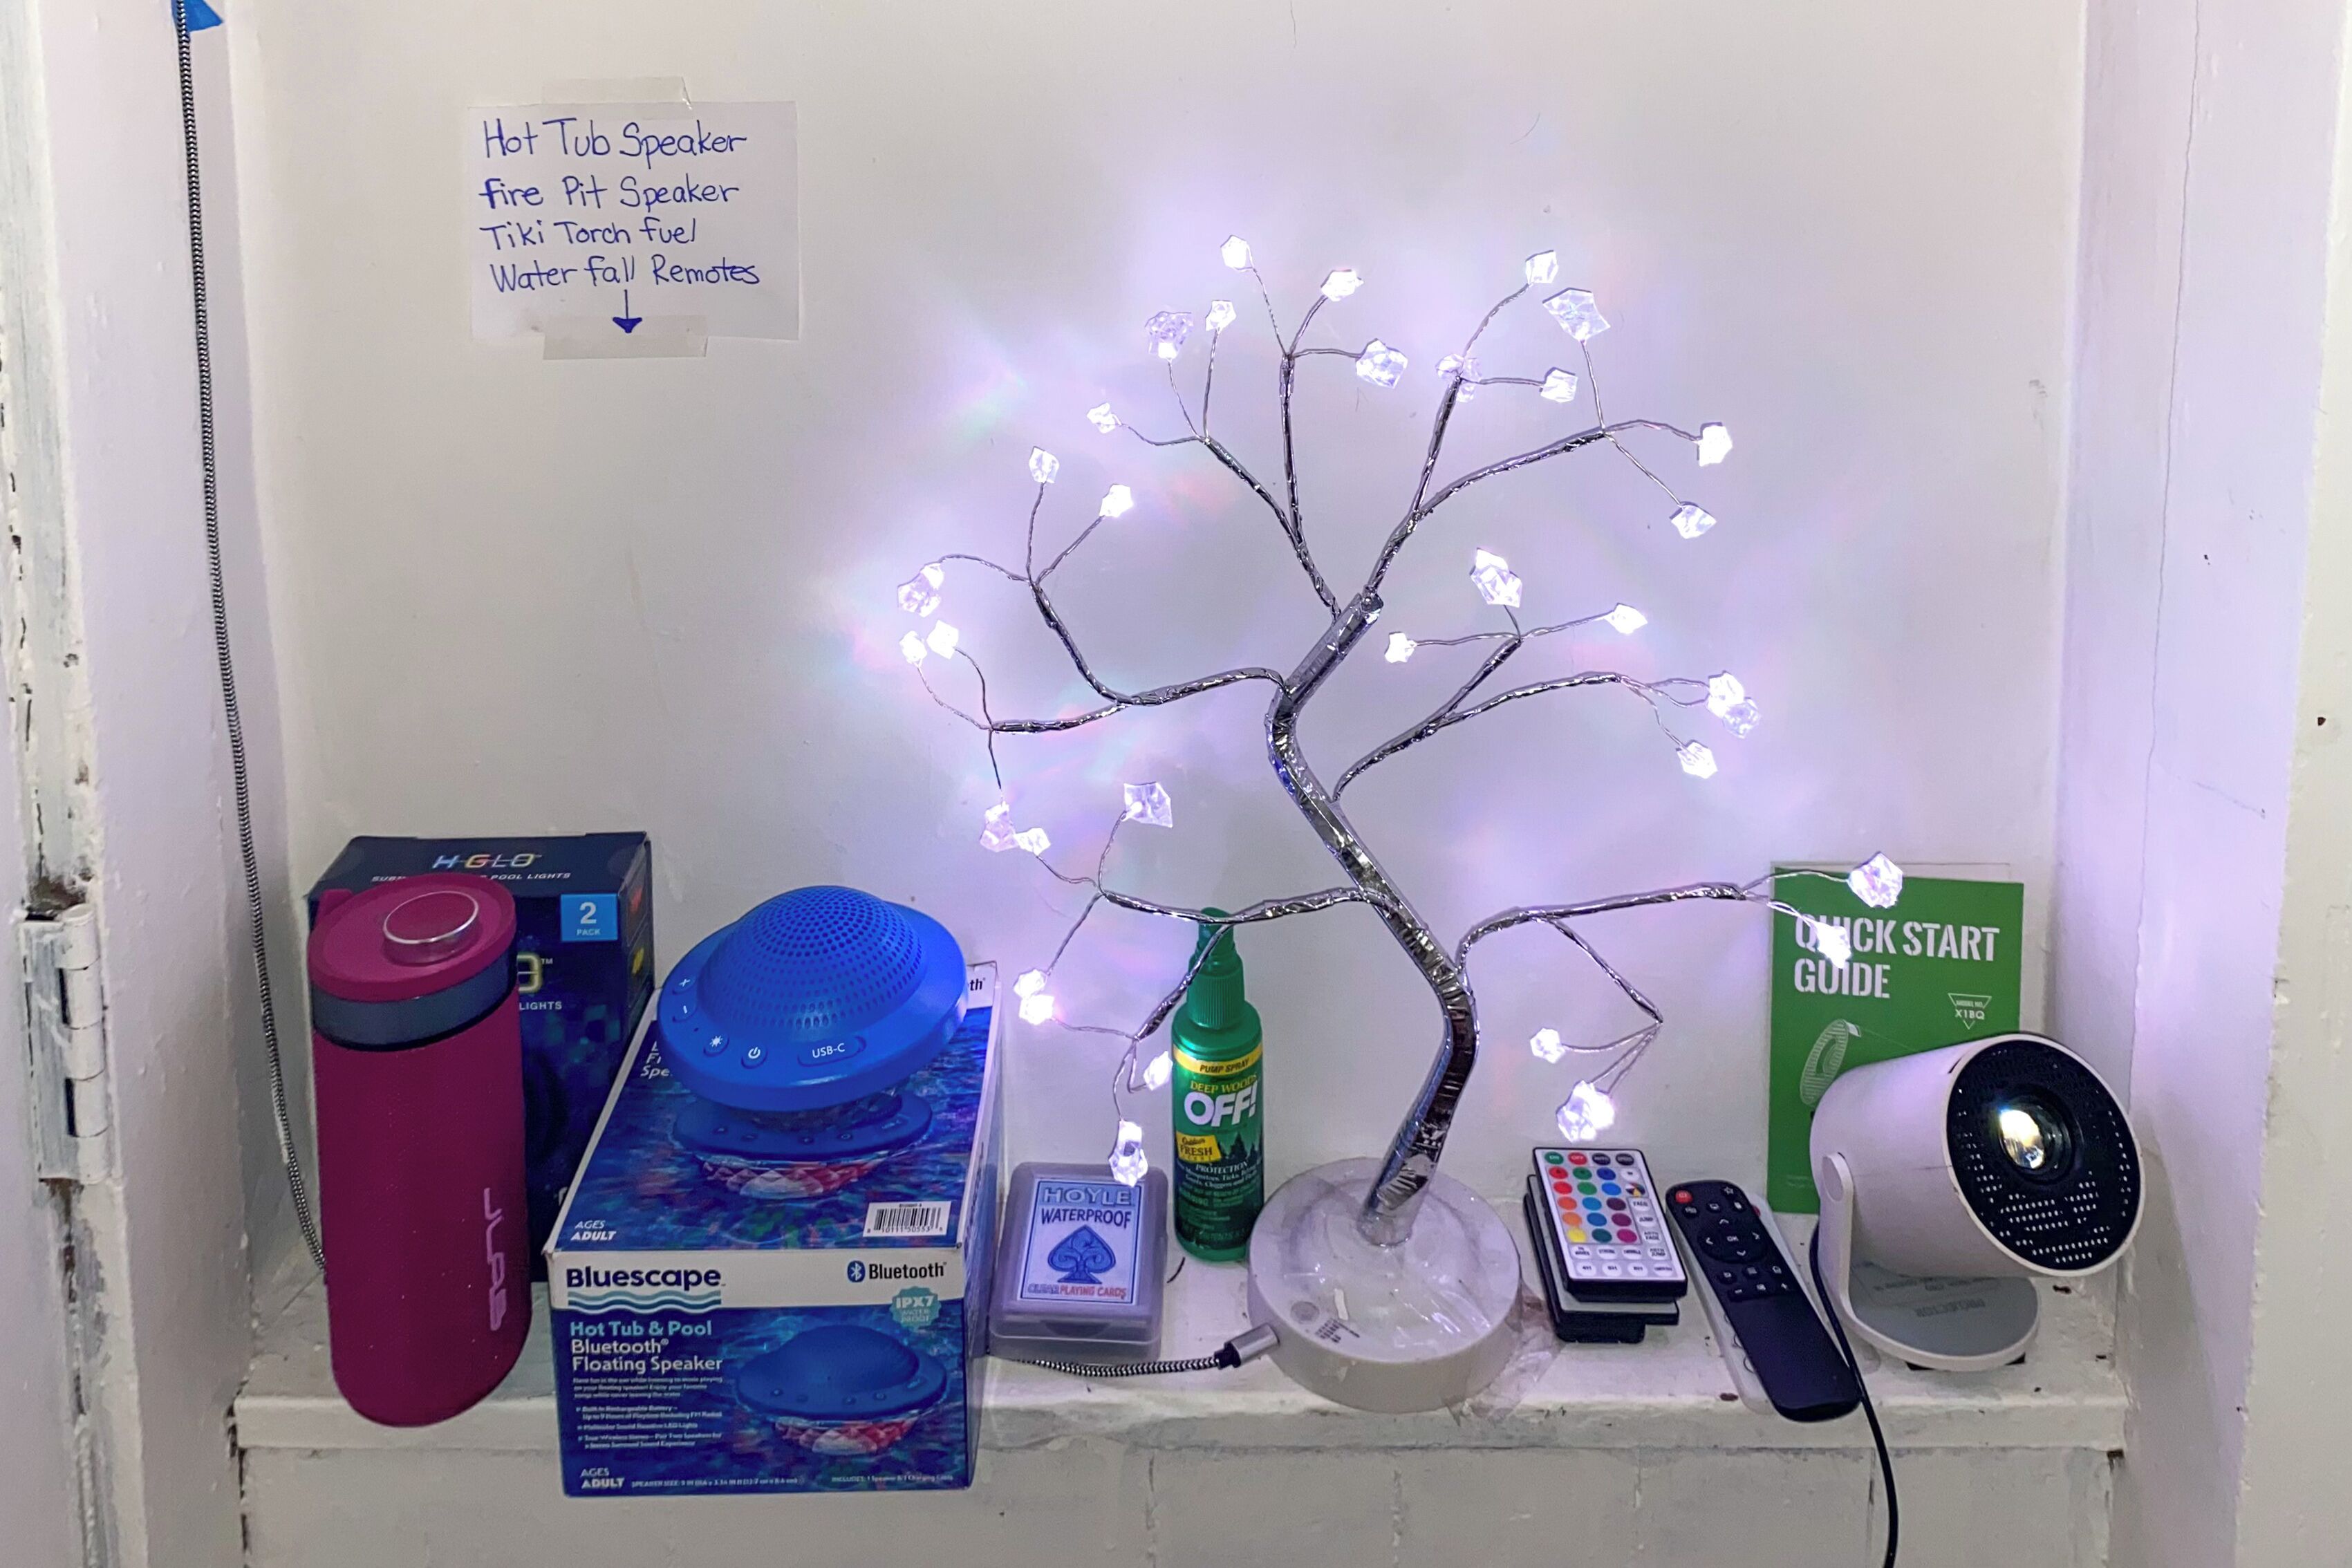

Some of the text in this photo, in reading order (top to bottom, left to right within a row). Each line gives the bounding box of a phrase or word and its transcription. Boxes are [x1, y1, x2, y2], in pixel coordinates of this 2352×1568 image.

[484, 118, 747, 169] Hot Tub Speaker
[562, 174, 608, 209] Pit
[620, 173, 740, 212] Speaker
[480, 220, 544, 250] Tiki
[553, 221, 631, 245] Torch
[651, 254, 760, 286] Remotes
[528, 872, 572, 880] LIGHTS
[579, 902, 597, 924] 2
[1903, 921, 2000, 962] START
[1794, 958, 1891, 998] GUIDE
[519, 1000, 563, 1011] LIGHTS
[812, 1043, 846, 1059] USB-C
[1200, 1058, 1250, 1073] PUMP SPRAY
[1191, 1080, 1218, 1093] DEEP
[1184, 1080, 1258, 1127] OFF!
[1180, 1145, 1213, 1156] FRESH
[1195, 1161, 1247, 1174] PROTECTION
[1044, 1186, 1132, 1206] HOYLE
[575, 1220, 606, 1229] AGES
[1041, 1208, 1132, 1229] WATERPROOF
[570, 1231, 617, 1241] ADULT
[566, 1266, 722, 1291] Bluescape
[1060, 1285, 1094, 1297] PLAYING
[1097, 1287, 1126, 1300] CARDS
[896, 1295, 935, 1309] IPX7
[570, 1320, 713, 1336] Hot Tub & Pool
[572, 1355, 723, 1374] Floating Speaker
[580, 1467, 610, 1477] AGES
[581, 1477, 625, 1489] ADULT
